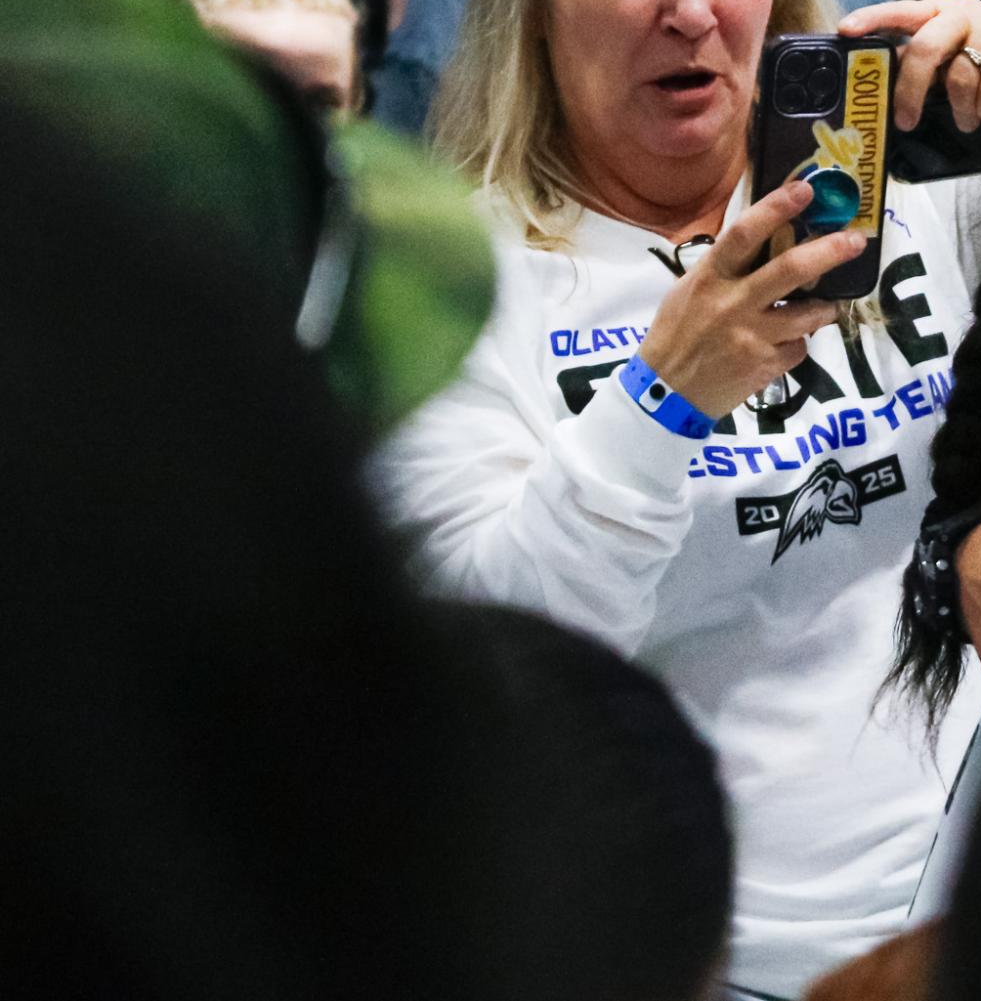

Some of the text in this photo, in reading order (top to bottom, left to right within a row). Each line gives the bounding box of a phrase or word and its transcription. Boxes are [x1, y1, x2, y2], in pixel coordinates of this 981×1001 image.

[550, 326, 651, 357] OLATH
[688, 407, 867, 478] ESTLING
[744, 465, 897, 526] 20 25
